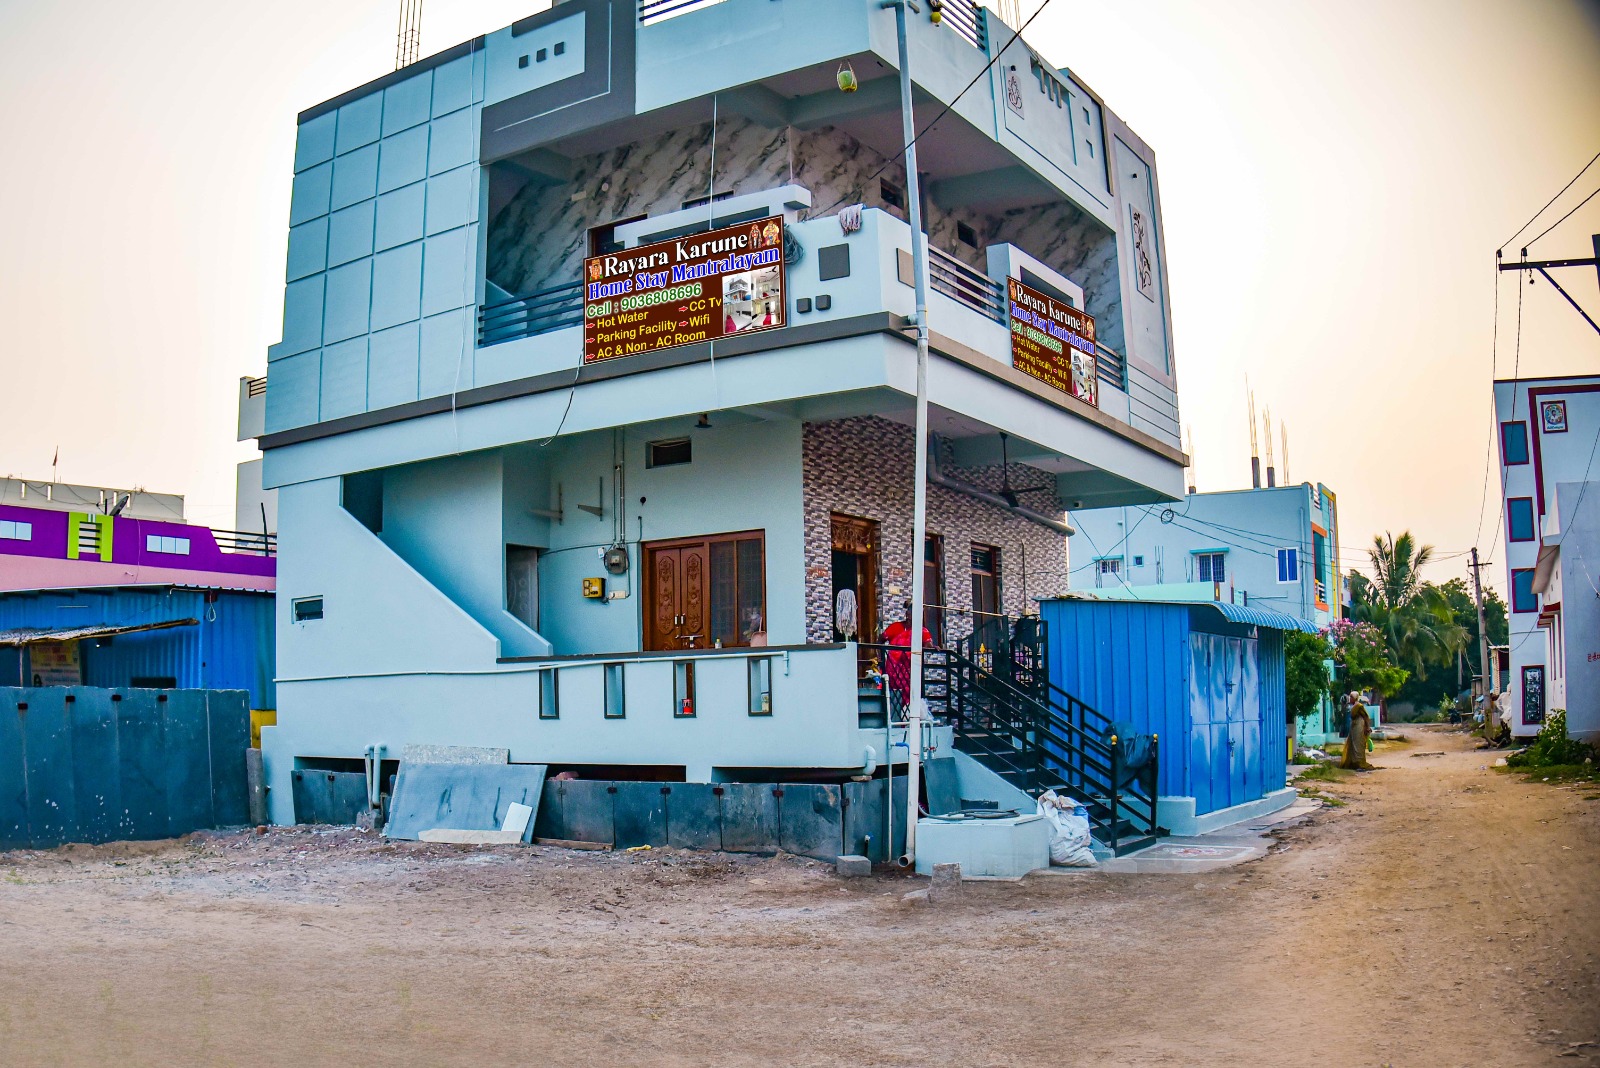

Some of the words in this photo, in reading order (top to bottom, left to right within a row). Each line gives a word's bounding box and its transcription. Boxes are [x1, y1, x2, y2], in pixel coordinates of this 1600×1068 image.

[605, 250, 669, 278] Rayara
[676, 233, 748, 261] Karune
[588, 280, 633, 301] Home
[635, 270, 669, 290] Stay
[672, 248, 780, 283] Mantralayam
[587, 301, 611, 318] Cell
[621, 284, 702, 311] 9036808696
[689, 300, 706, 312] CC
[709, 298, 722, 307] Tv
[1017, 284, 1046, 315] Rayara
[1049, 300, 1081, 331] Karune
[597, 317, 615, 329] Hot
[618, 311, 649, 325] Water
[597, 329, 637, 344] Parking
[639, 320, 677, 336] Facility
[689, 314, 710, 327] Wifi
[1011, 320, 1023, 333] Cell
[1011, 301, 1031, 324] Home
[1032, 311, 1047, 333] Stay
[1048, 319, 1094, 355] Mantralayam
[597, 346, 613, 359] AC
[615, 345, 623, 355] &
[625, 342, 647, 353] Non
[656, 336, 672, 348] AC
[674, 329, 706, 344] Room
[1017, 335, 1025, 347] Hot
[1026, 340, 1040, 354] Water
[1018, 348, 1035, 365] Parking
[1057, 356, 1065, 367] CC
[1019, 361, 1026, 371] AC
[1044, 373, 1052, 383] AC
[1052, 377, 1066, 390] Room
